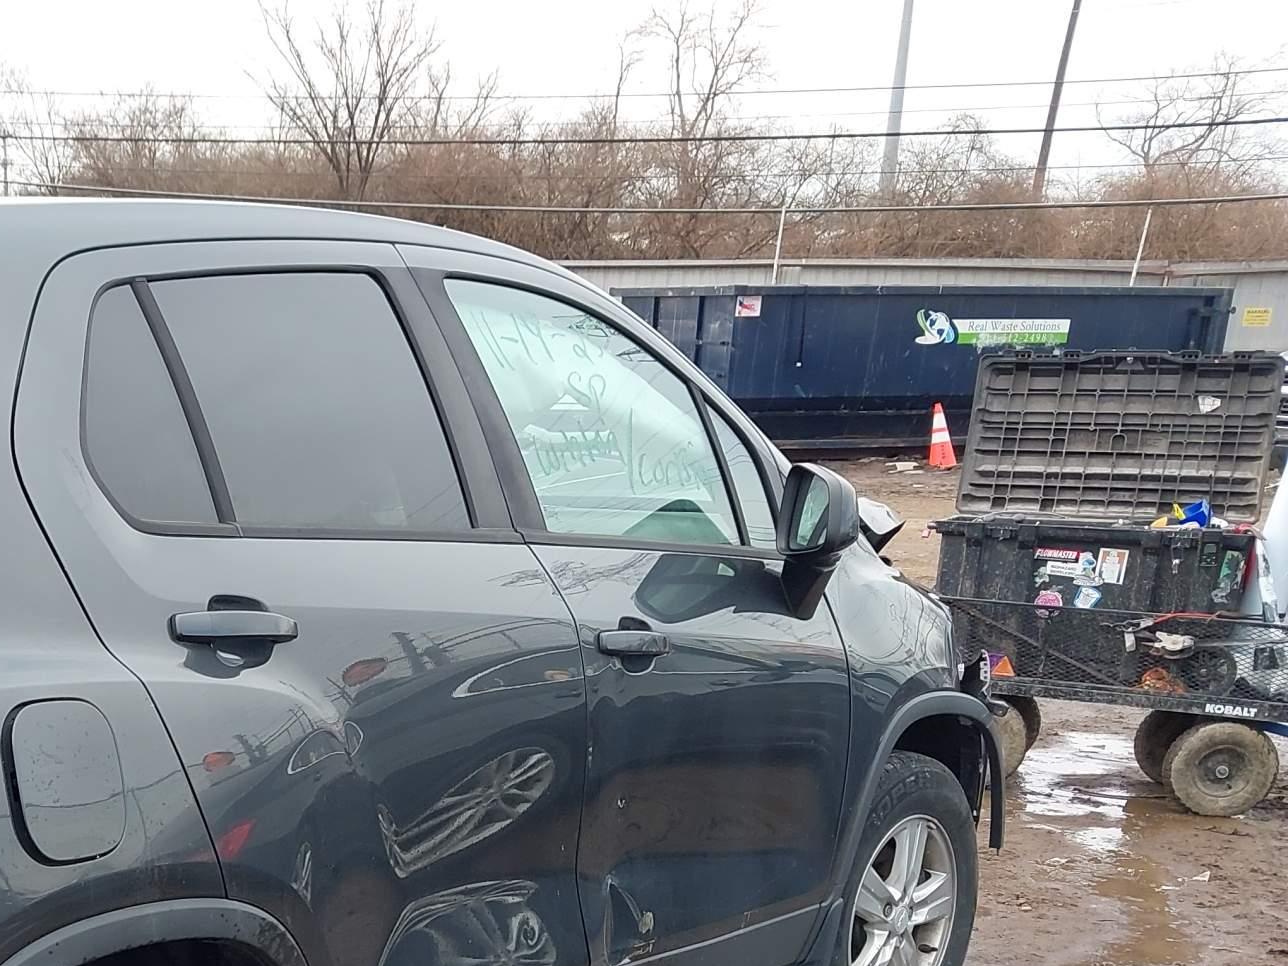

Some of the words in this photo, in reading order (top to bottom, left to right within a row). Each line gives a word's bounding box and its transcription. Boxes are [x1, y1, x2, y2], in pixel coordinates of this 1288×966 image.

[967, 320, 988, 332] Real
[992, 320, 1018, 332] Waste
[1019, 320, 1061, 332] Solutions
[1205, 703, 1258, 718] KOBALT
